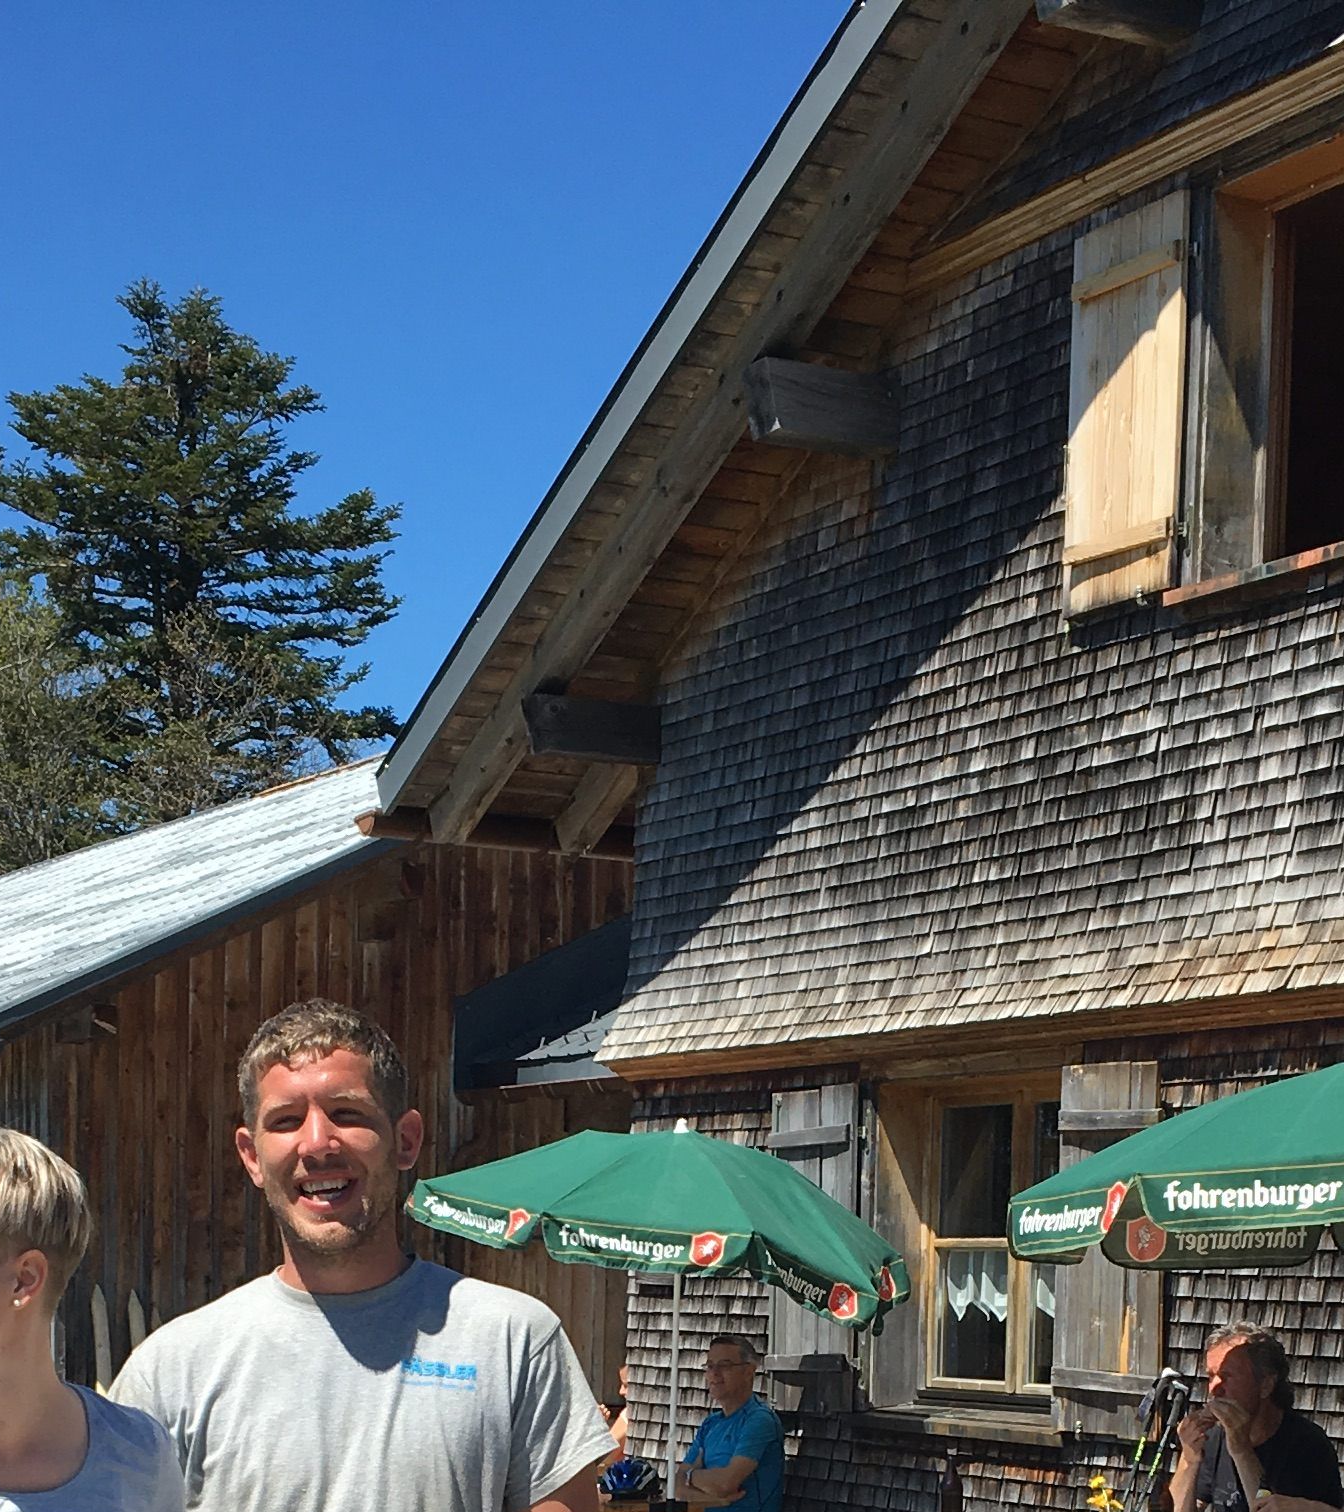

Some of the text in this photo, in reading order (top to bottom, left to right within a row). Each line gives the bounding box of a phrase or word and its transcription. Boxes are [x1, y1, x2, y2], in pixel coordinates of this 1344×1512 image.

[1163, 1179, 1344, 1212] fohrenburger
[1018, 1204, 1104, 1236] fohrenburger
[558, 1223, 685, 1262] fohrenburger
